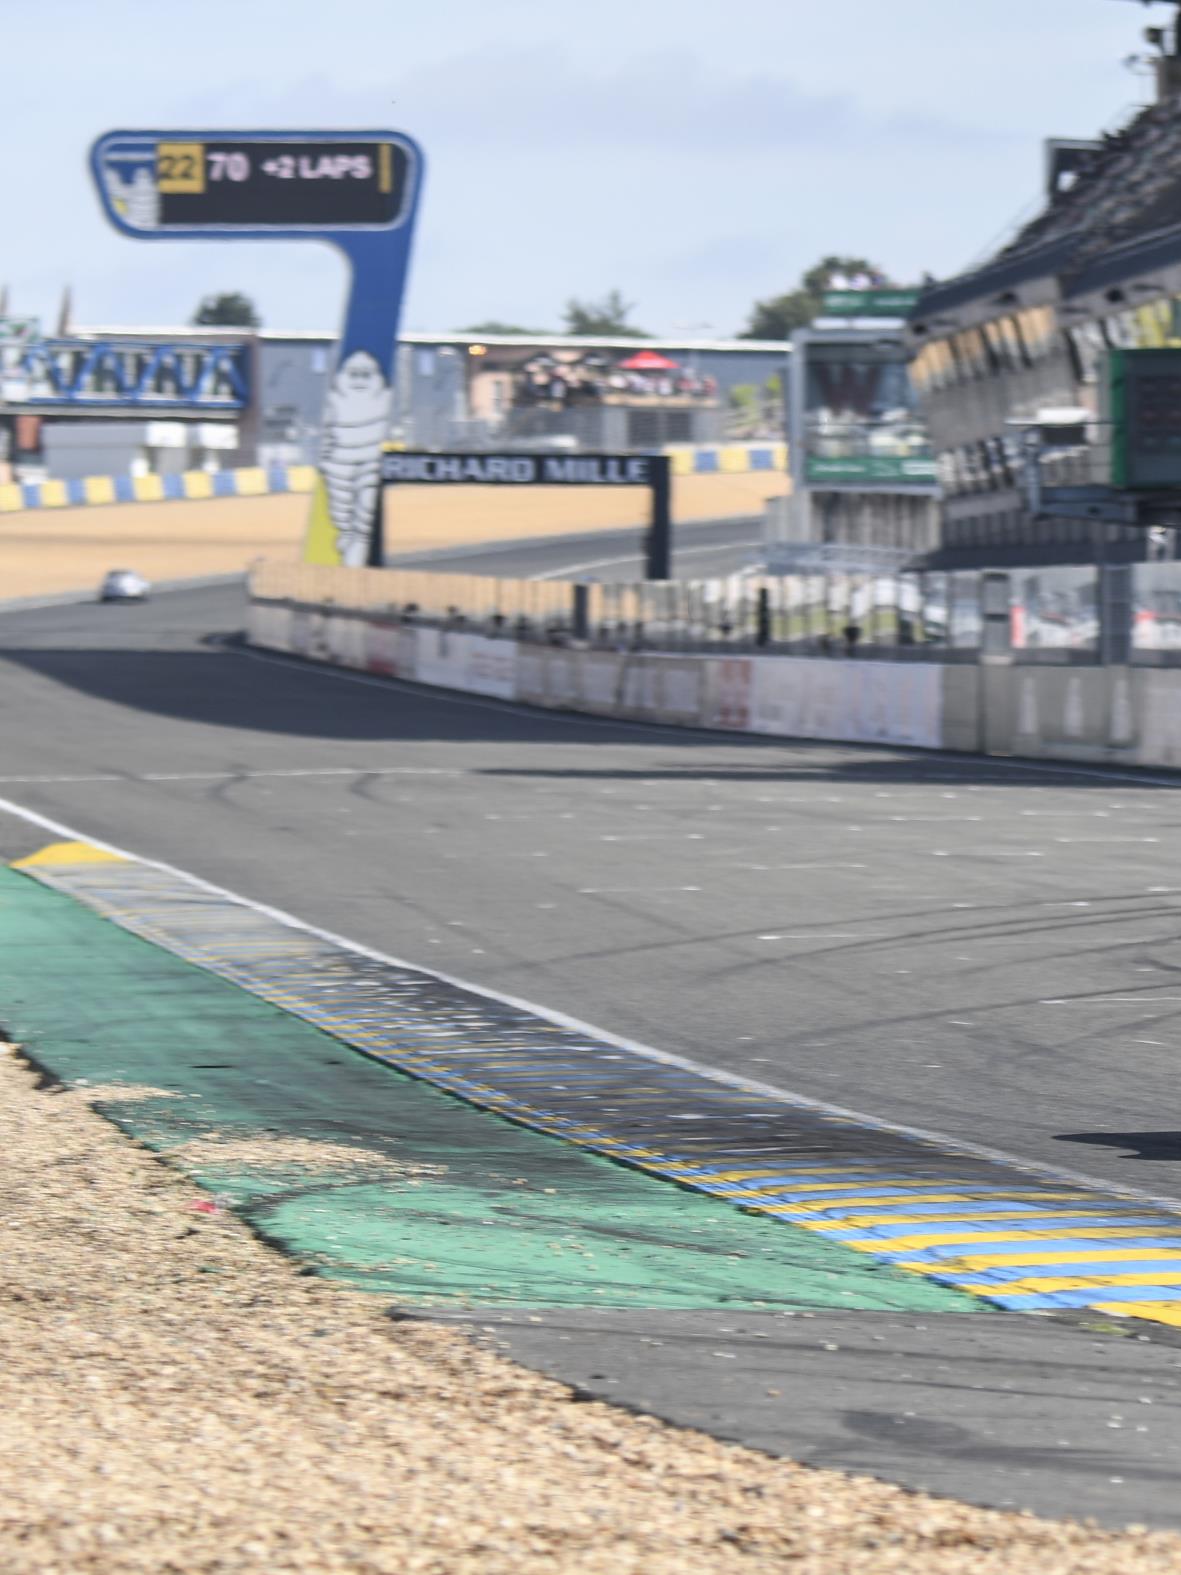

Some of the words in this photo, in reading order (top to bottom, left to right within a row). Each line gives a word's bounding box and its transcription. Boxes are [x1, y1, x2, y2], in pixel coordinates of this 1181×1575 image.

[206, 152, 250, 182] 70
[299, 155, 373, 179] LAPS
[383, 456, 535, 482] RICHARD
[544, 458, 650, 483] MILLE
